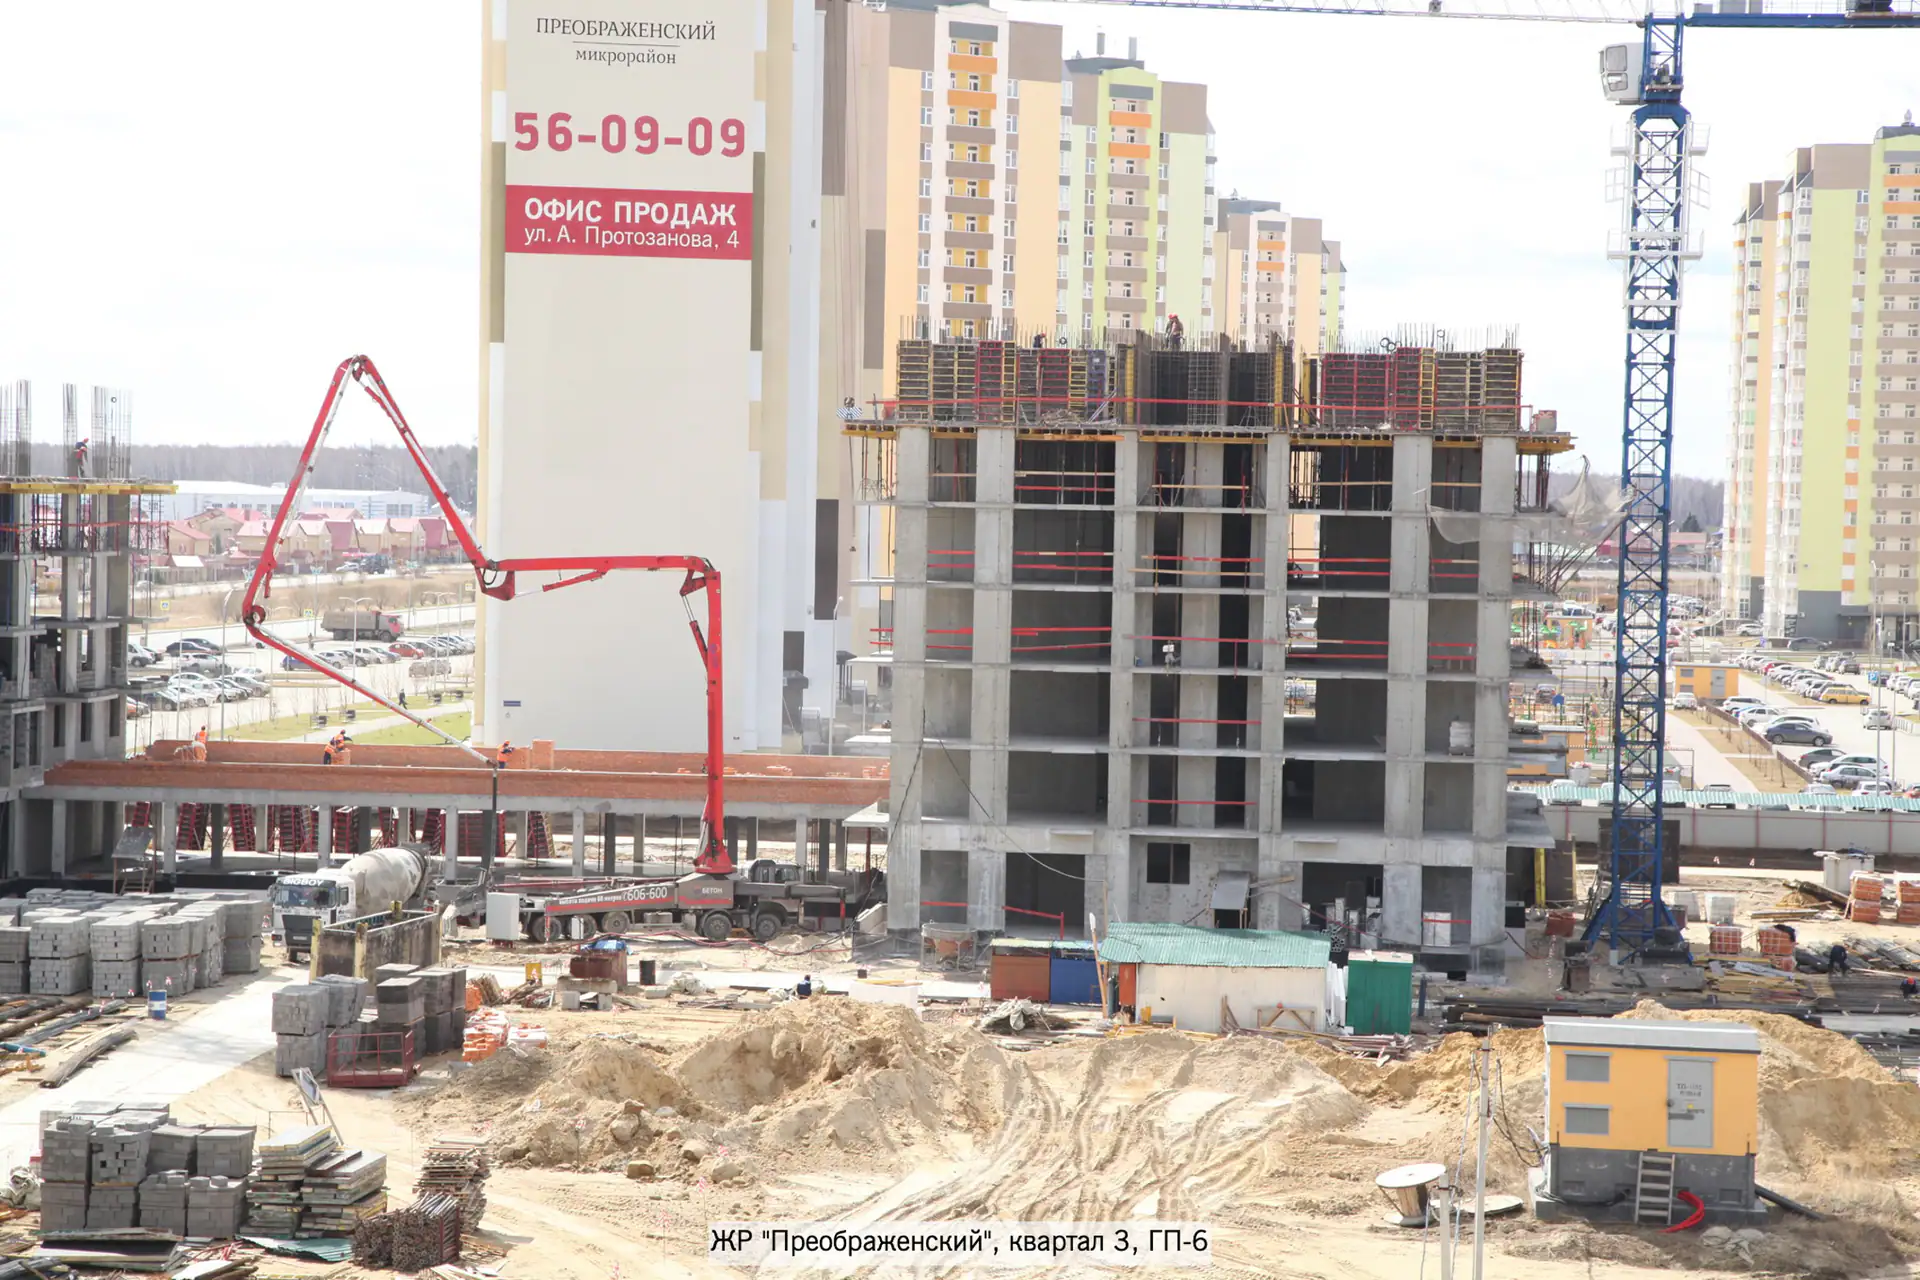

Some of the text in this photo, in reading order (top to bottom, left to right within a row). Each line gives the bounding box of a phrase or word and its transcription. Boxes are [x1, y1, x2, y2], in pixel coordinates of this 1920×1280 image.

[536, 17, 716, 41] ПРЕОБРАЖЕНСКИЙ
[575, 48, 677, 67] микрорайон
[514, 112, 745, 158] 56-09-09
[524, 197, 737, 229] ОФИС ПРОДАЖ
[524, 225, 740, 252] ул. А. Протозанова, 4
[283, 877, 323, 886] BIGBOY
